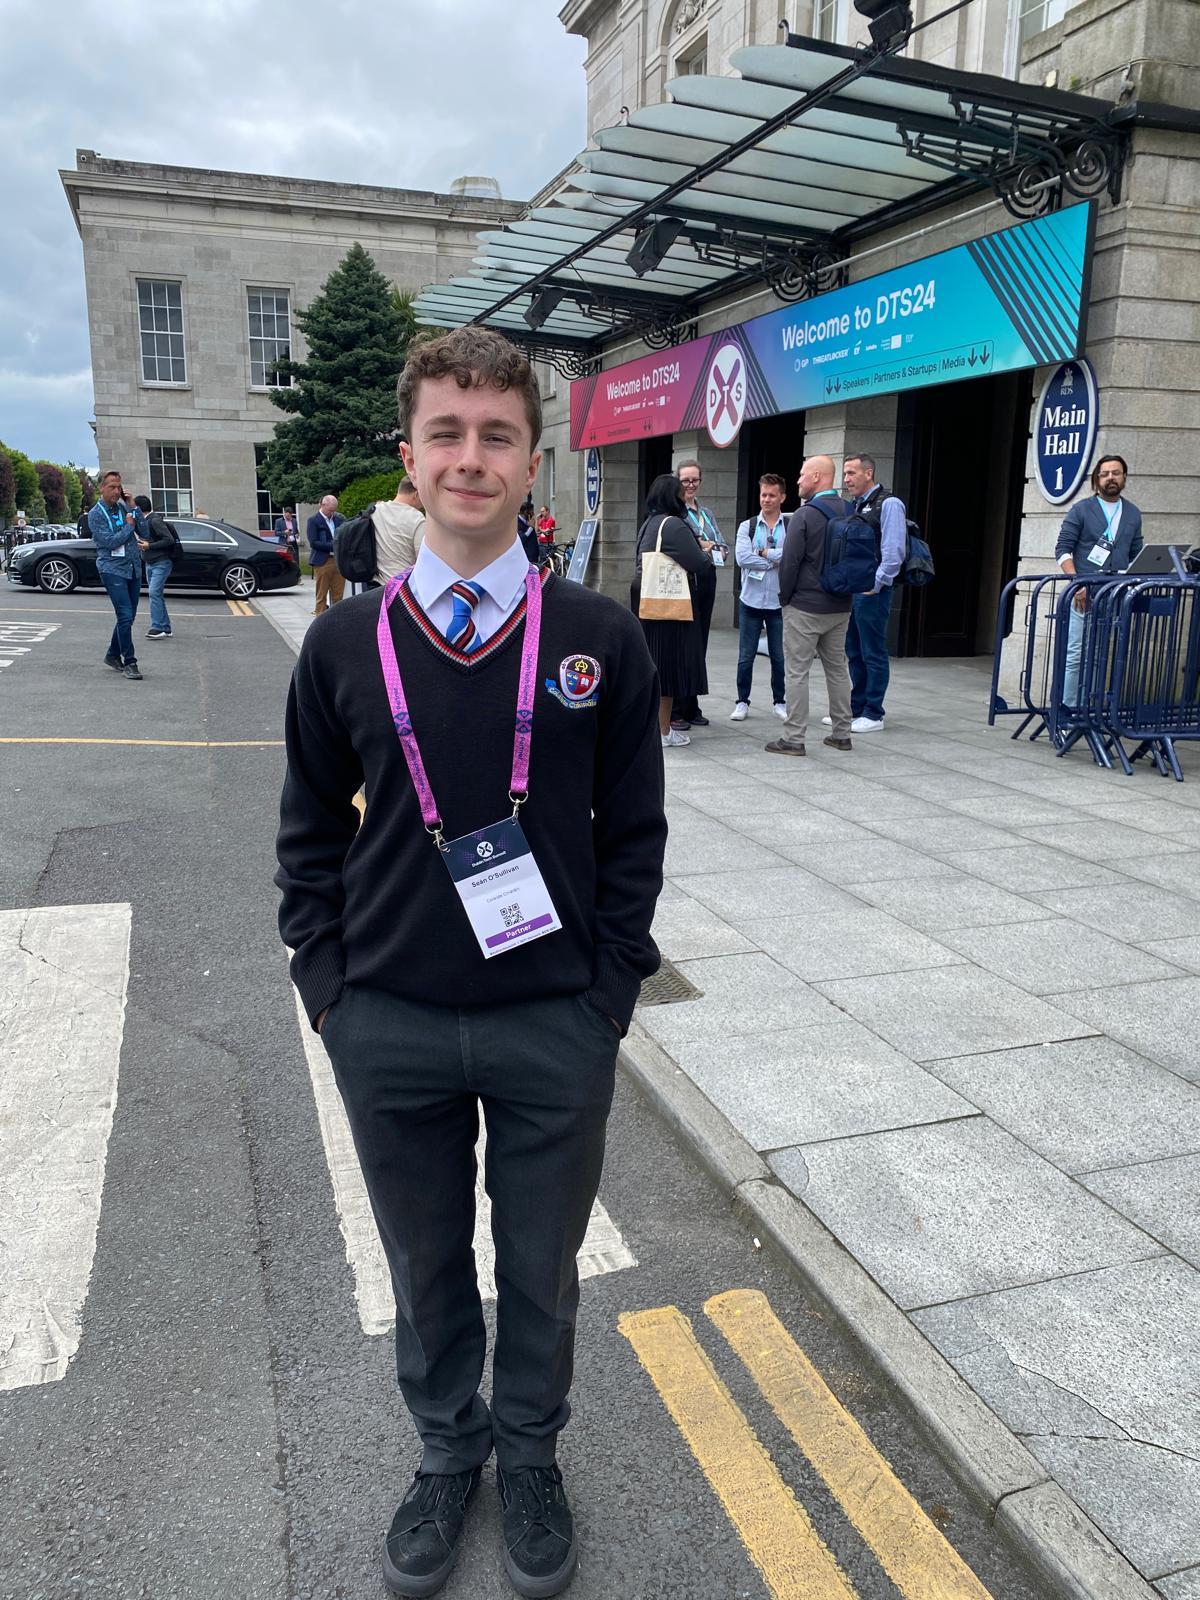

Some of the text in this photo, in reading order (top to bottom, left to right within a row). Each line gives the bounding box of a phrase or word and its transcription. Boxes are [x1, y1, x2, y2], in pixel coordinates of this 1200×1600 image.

[782, 279, 936, 351] Welcome to DTS24
[606, 361, 681, 401] Welcome to DTS24
[842, 356, 966, 392] Speakers Partners & Startups Media
[709, 382, 742, 408] DTS
[1043, 404, 1086, 429] Main
[1043, 432, 1080, 456] Hall
[1054, 466, 1064, 490] 1
[518, 736, 526, 760] Partner
[488, 865, 520, 881] O'Sullivan
[505, 924, 532, 939] Partner
